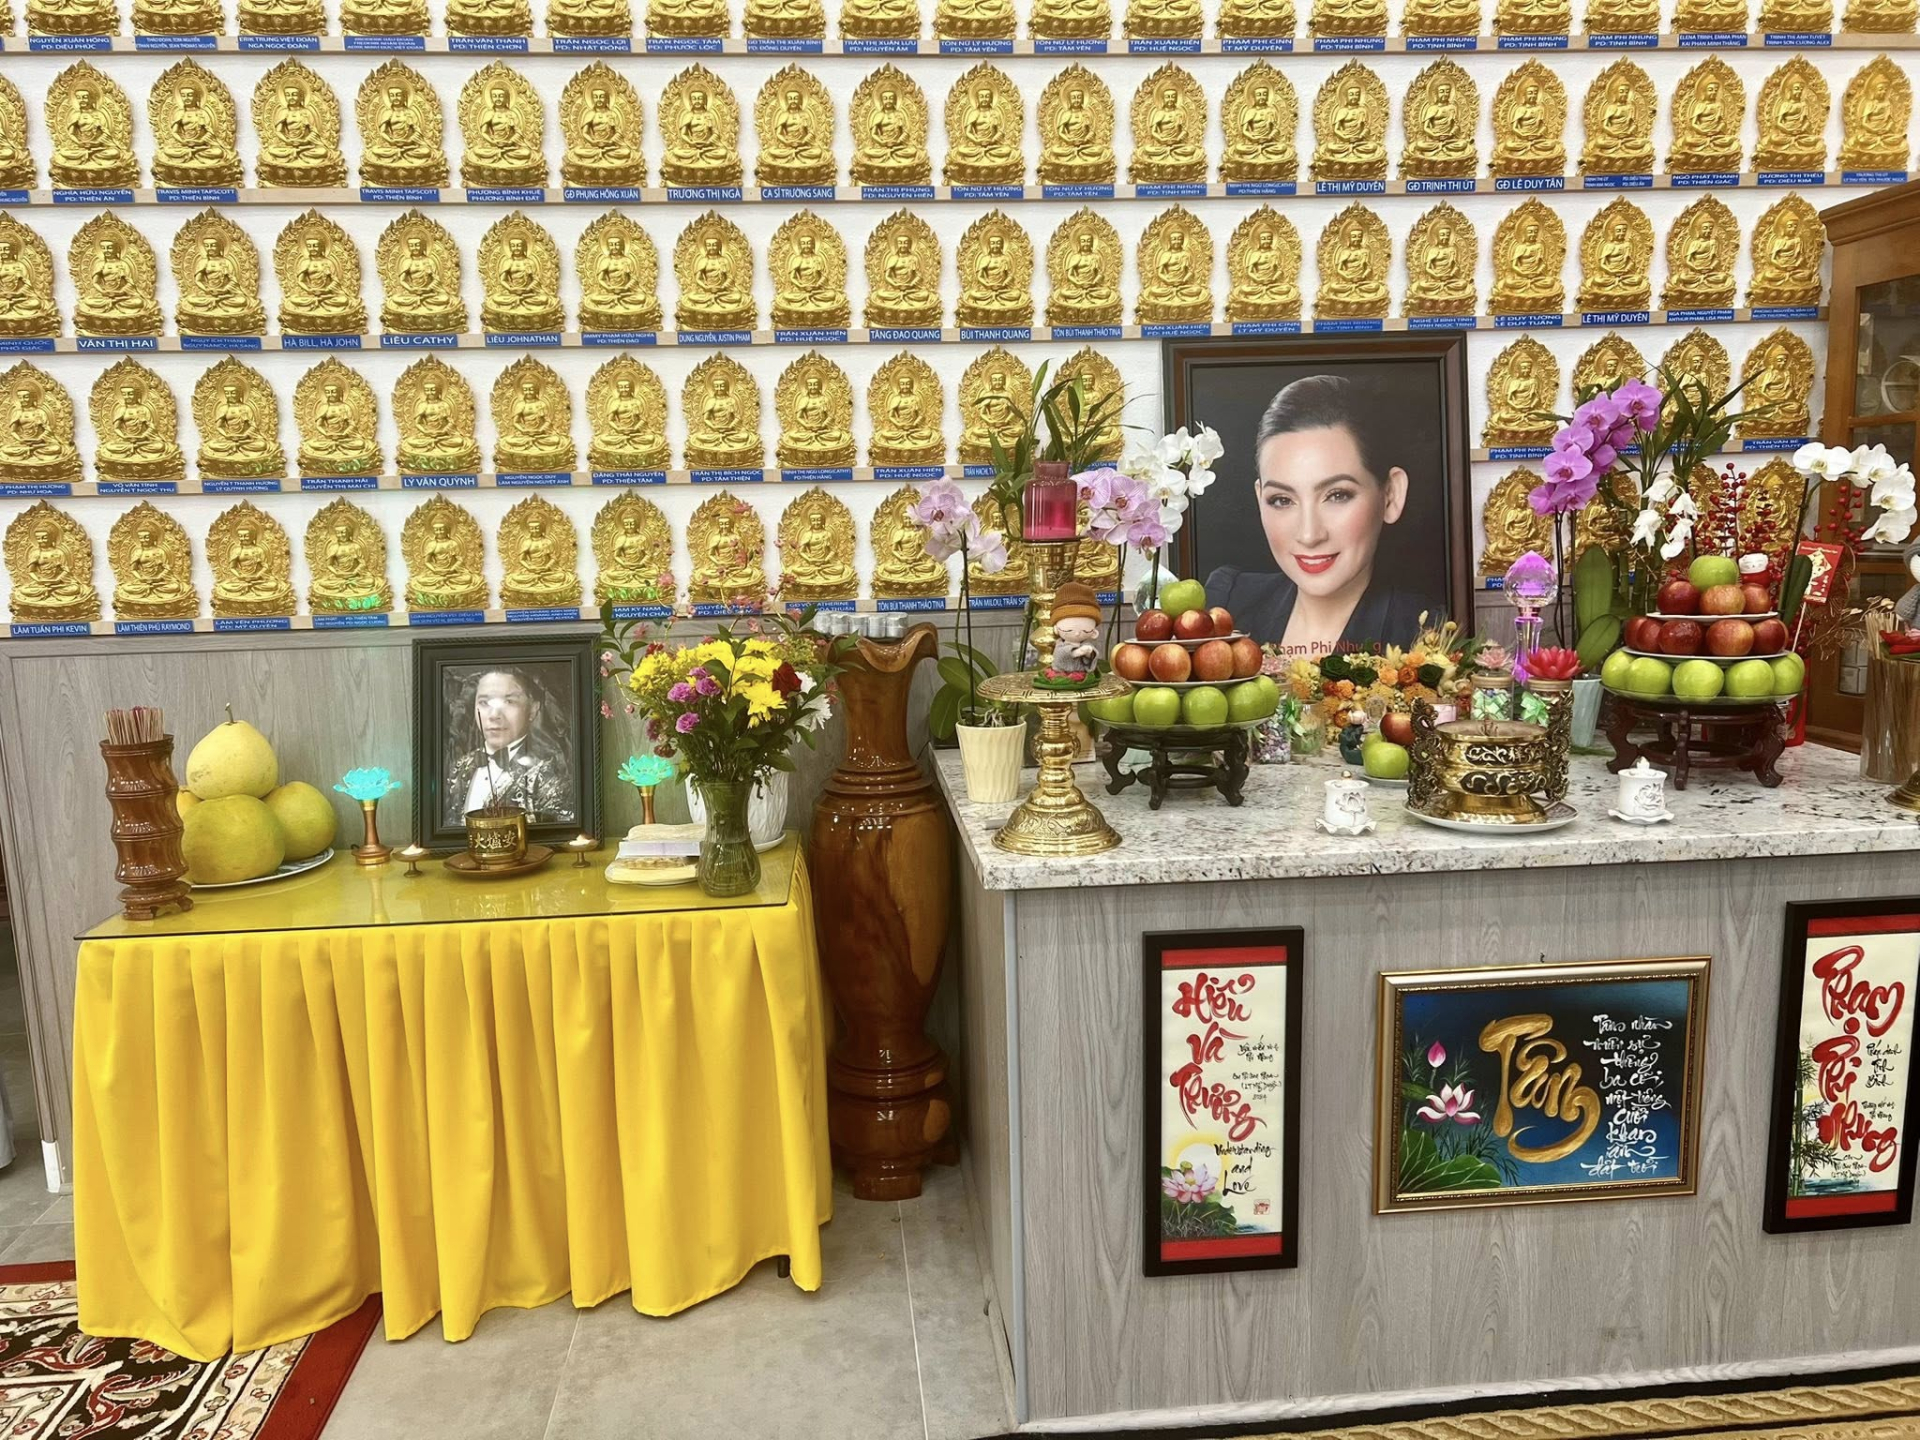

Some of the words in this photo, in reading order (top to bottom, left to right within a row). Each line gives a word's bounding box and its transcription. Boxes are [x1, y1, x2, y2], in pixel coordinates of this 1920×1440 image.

[1524, 179, 1543, 188] DUY
[762, 189, 772, 197] CA
[813, 188, 832, 197] SANG
[911, 330, 940, 339] QUANG
[975, 330, 1000, 338] THANH
[1002, 330, 1029, 339] QUANG
[335, 339, 358, 347] JOHN
[413, 336, 454, 344] CATHY
[1311, 641, 1332, 654] Phi
[1186, 1022, 1250, 1065] Và
[1478, 1013, 1601, 1162] Tâm
[1231, 1157, 1253, 1174] and
[1223, 1170, 1257, 1196] Love
